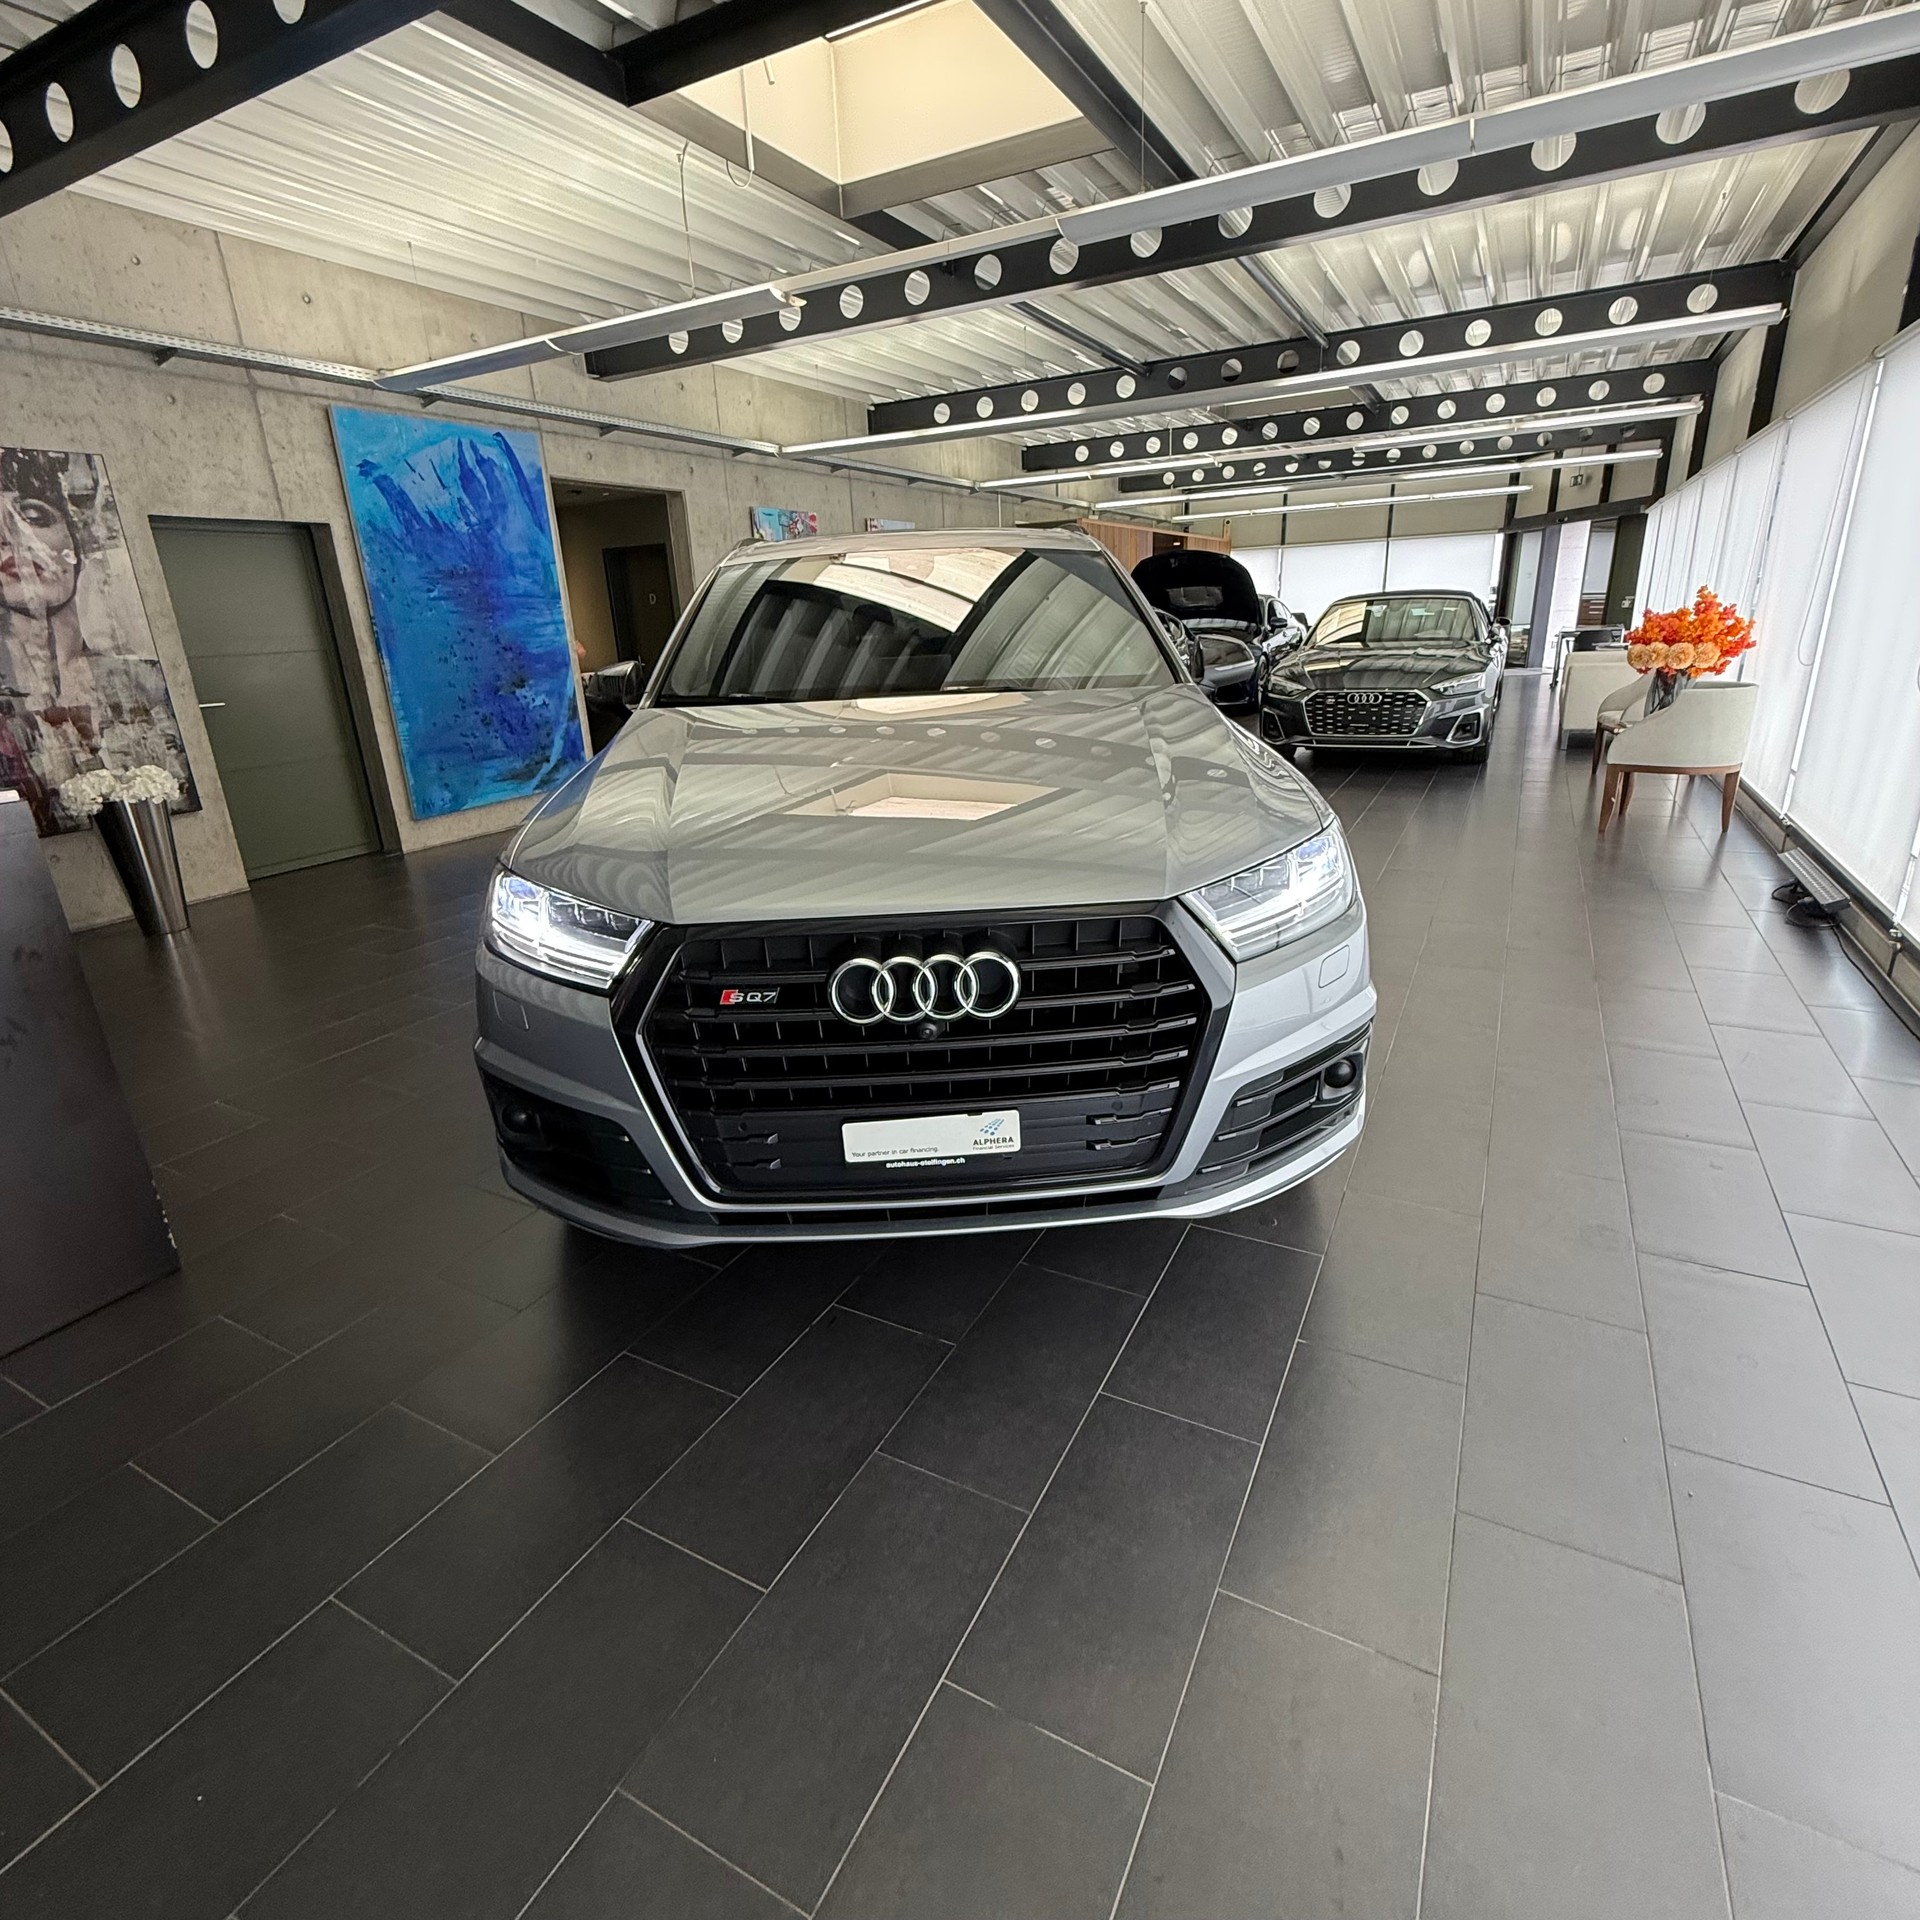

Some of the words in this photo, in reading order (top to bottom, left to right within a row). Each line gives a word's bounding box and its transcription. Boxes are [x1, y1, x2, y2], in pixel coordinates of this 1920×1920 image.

[728, 992, 777, 1003] SQ7
[973, 1136, 1015, 1146] ALPHERA
[867, 1149, 890, 1158] partner
[910, 1146, 939, 1154] financing.
